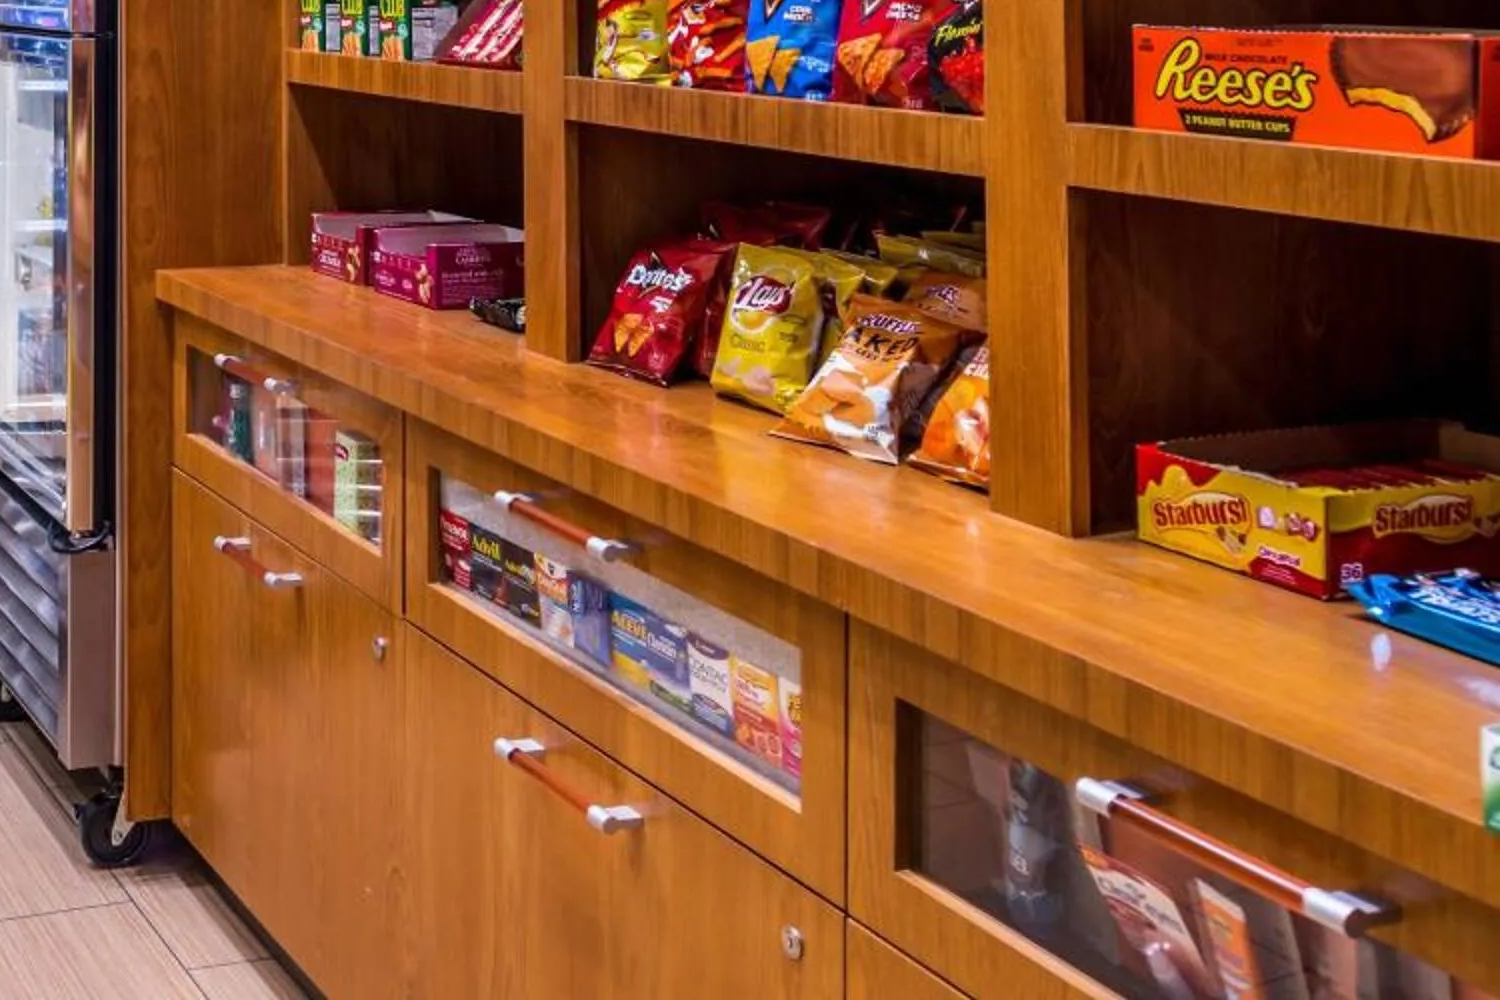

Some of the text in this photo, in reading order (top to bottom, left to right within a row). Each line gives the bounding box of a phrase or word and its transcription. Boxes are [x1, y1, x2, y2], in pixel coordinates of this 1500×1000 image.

[1155, 38, 1318, 110] Reese's
[1230, 54, 1288, 65] CHOCOLATE
[1265, 120, 1290, 134] CUPS
[1153, 497, 1249, 528] Starburst
[1375, 499, 1474, 534] Starburst
